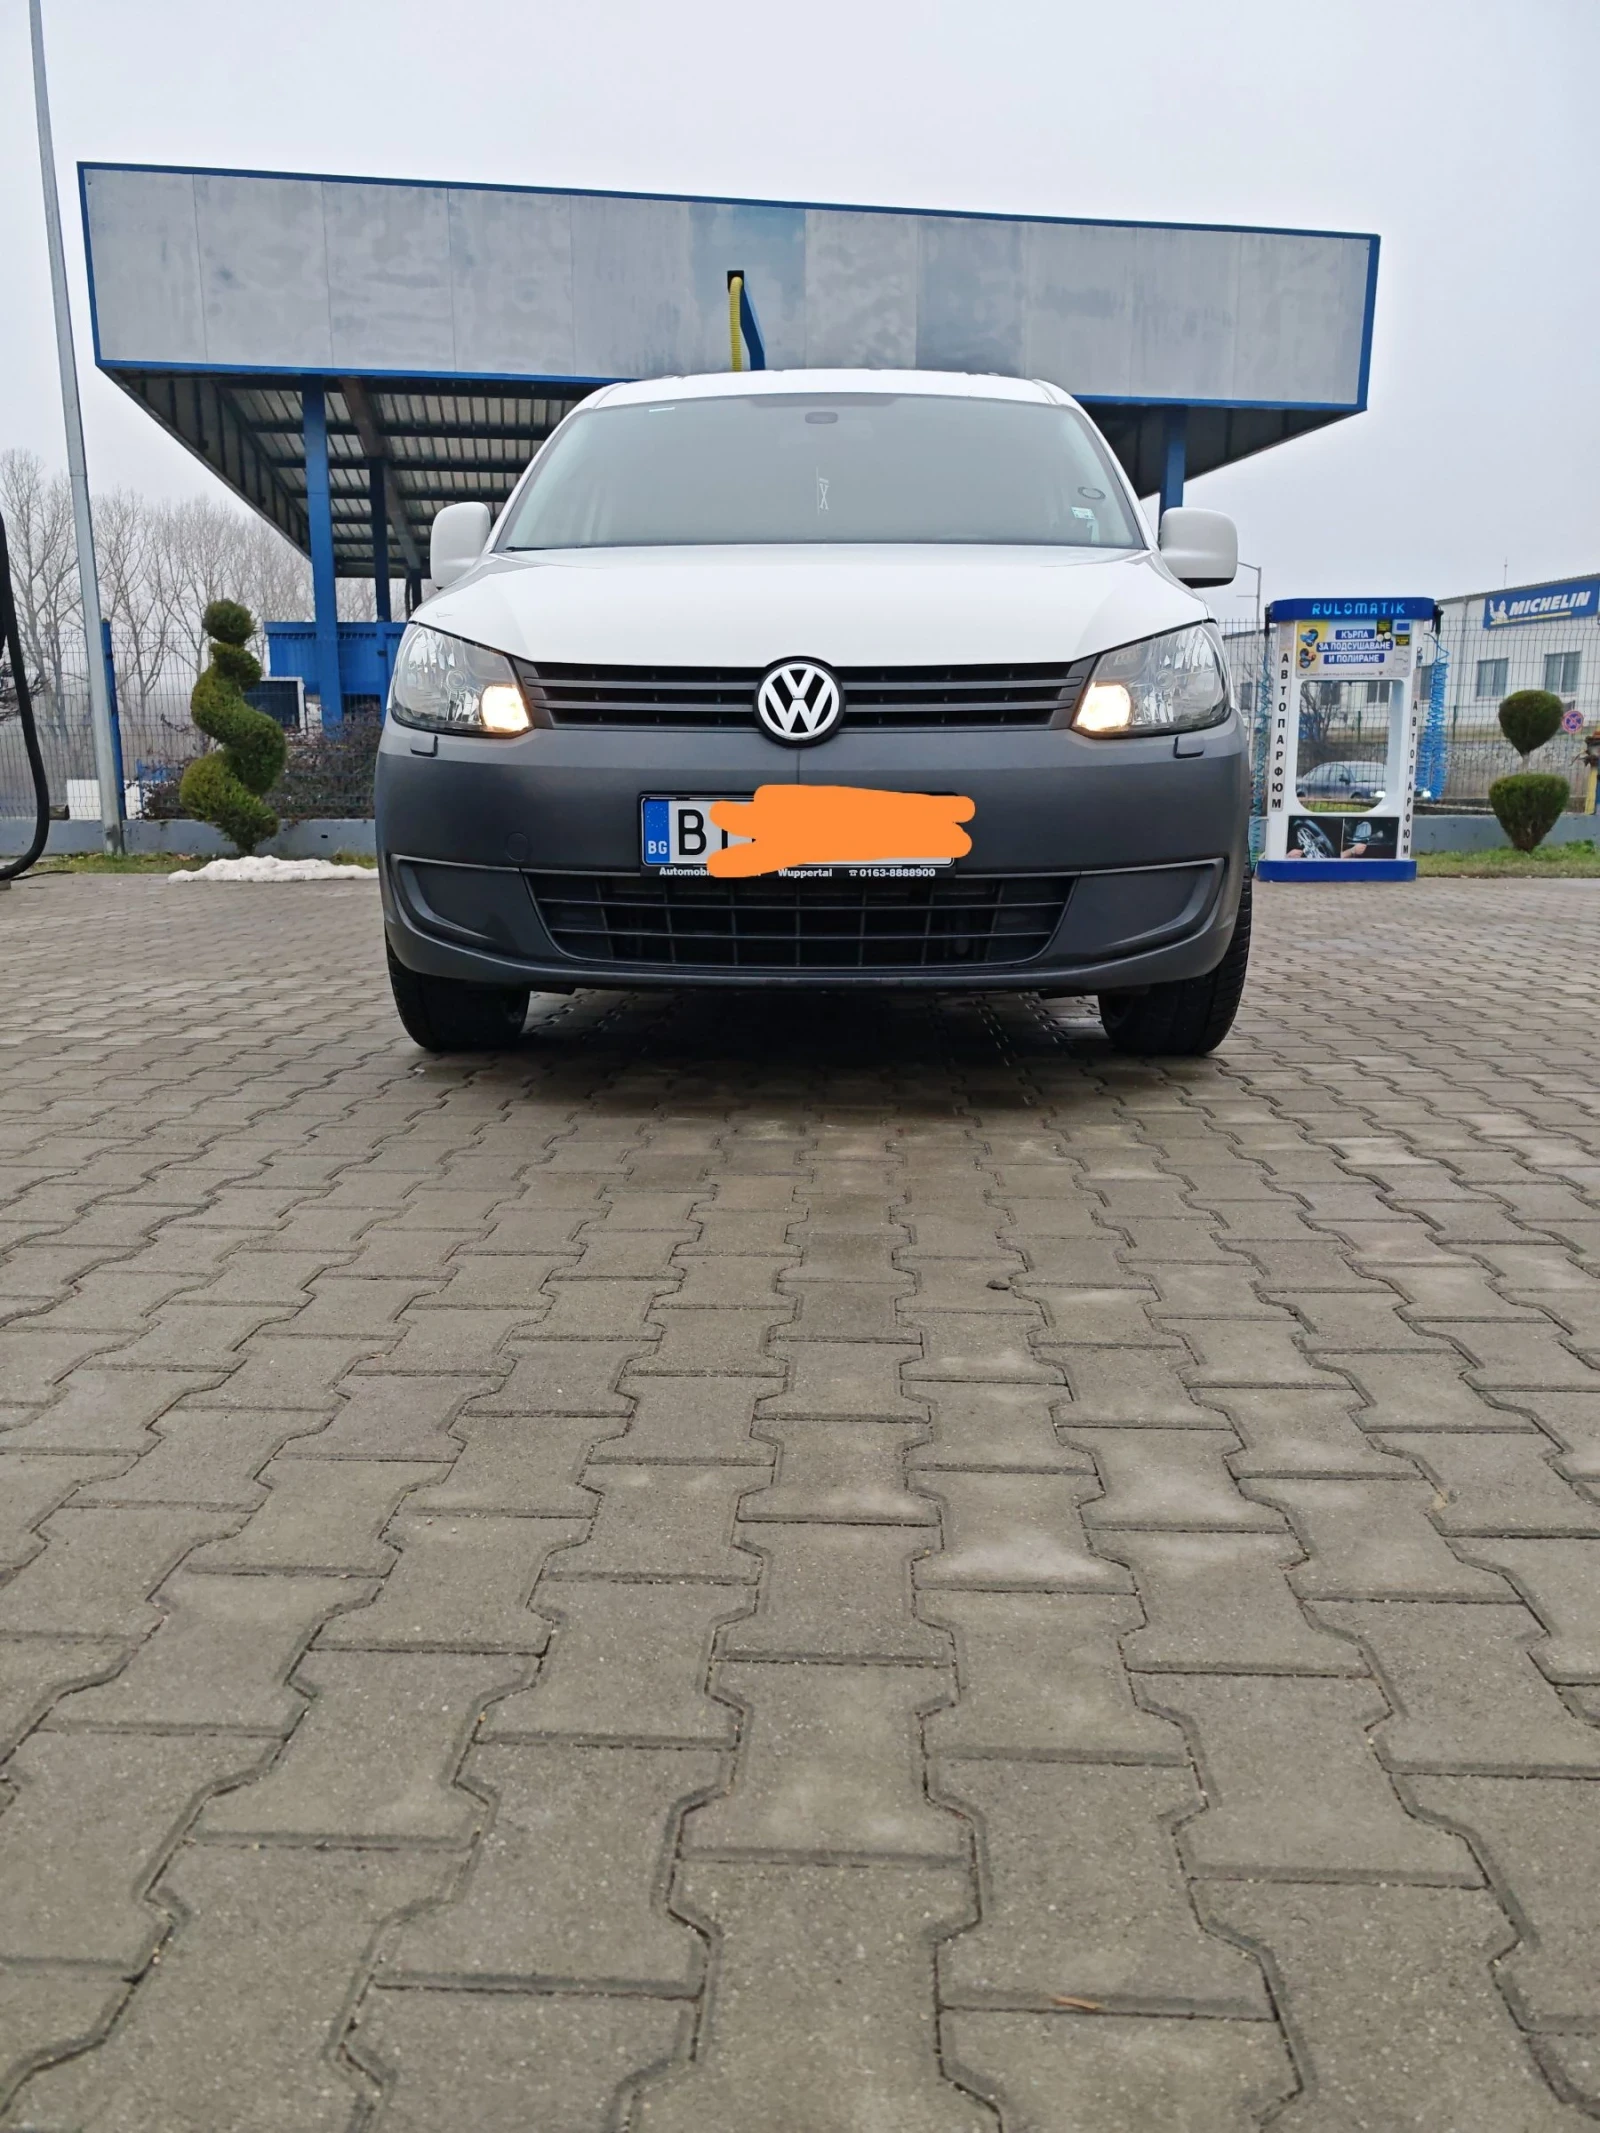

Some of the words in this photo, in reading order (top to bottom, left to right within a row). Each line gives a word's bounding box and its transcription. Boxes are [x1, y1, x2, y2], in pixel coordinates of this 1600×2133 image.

[1312, 602, 1406, 615] RULOMATIK
[1509, 591, 1591, 616] MICHELIN
[1341, 629, 1369, 639] КЪРПА
[1318, 642, 1329, 651] ЗА
[1331, 640, 1391, 651] ПОДСУШАВАНЕ
[1328, 654, 1336, 663] И
[1336, 653, 1380, 663] ПОЛИРАНЕ
[1271, 652, 1289, 809] АВТОПАРФЮМ
[1403, 700, 1418, 854] АВТОПАРФЮМ
[647, 840, 668, 855] BG
[778, 868, 833, 878] Wuppertal
